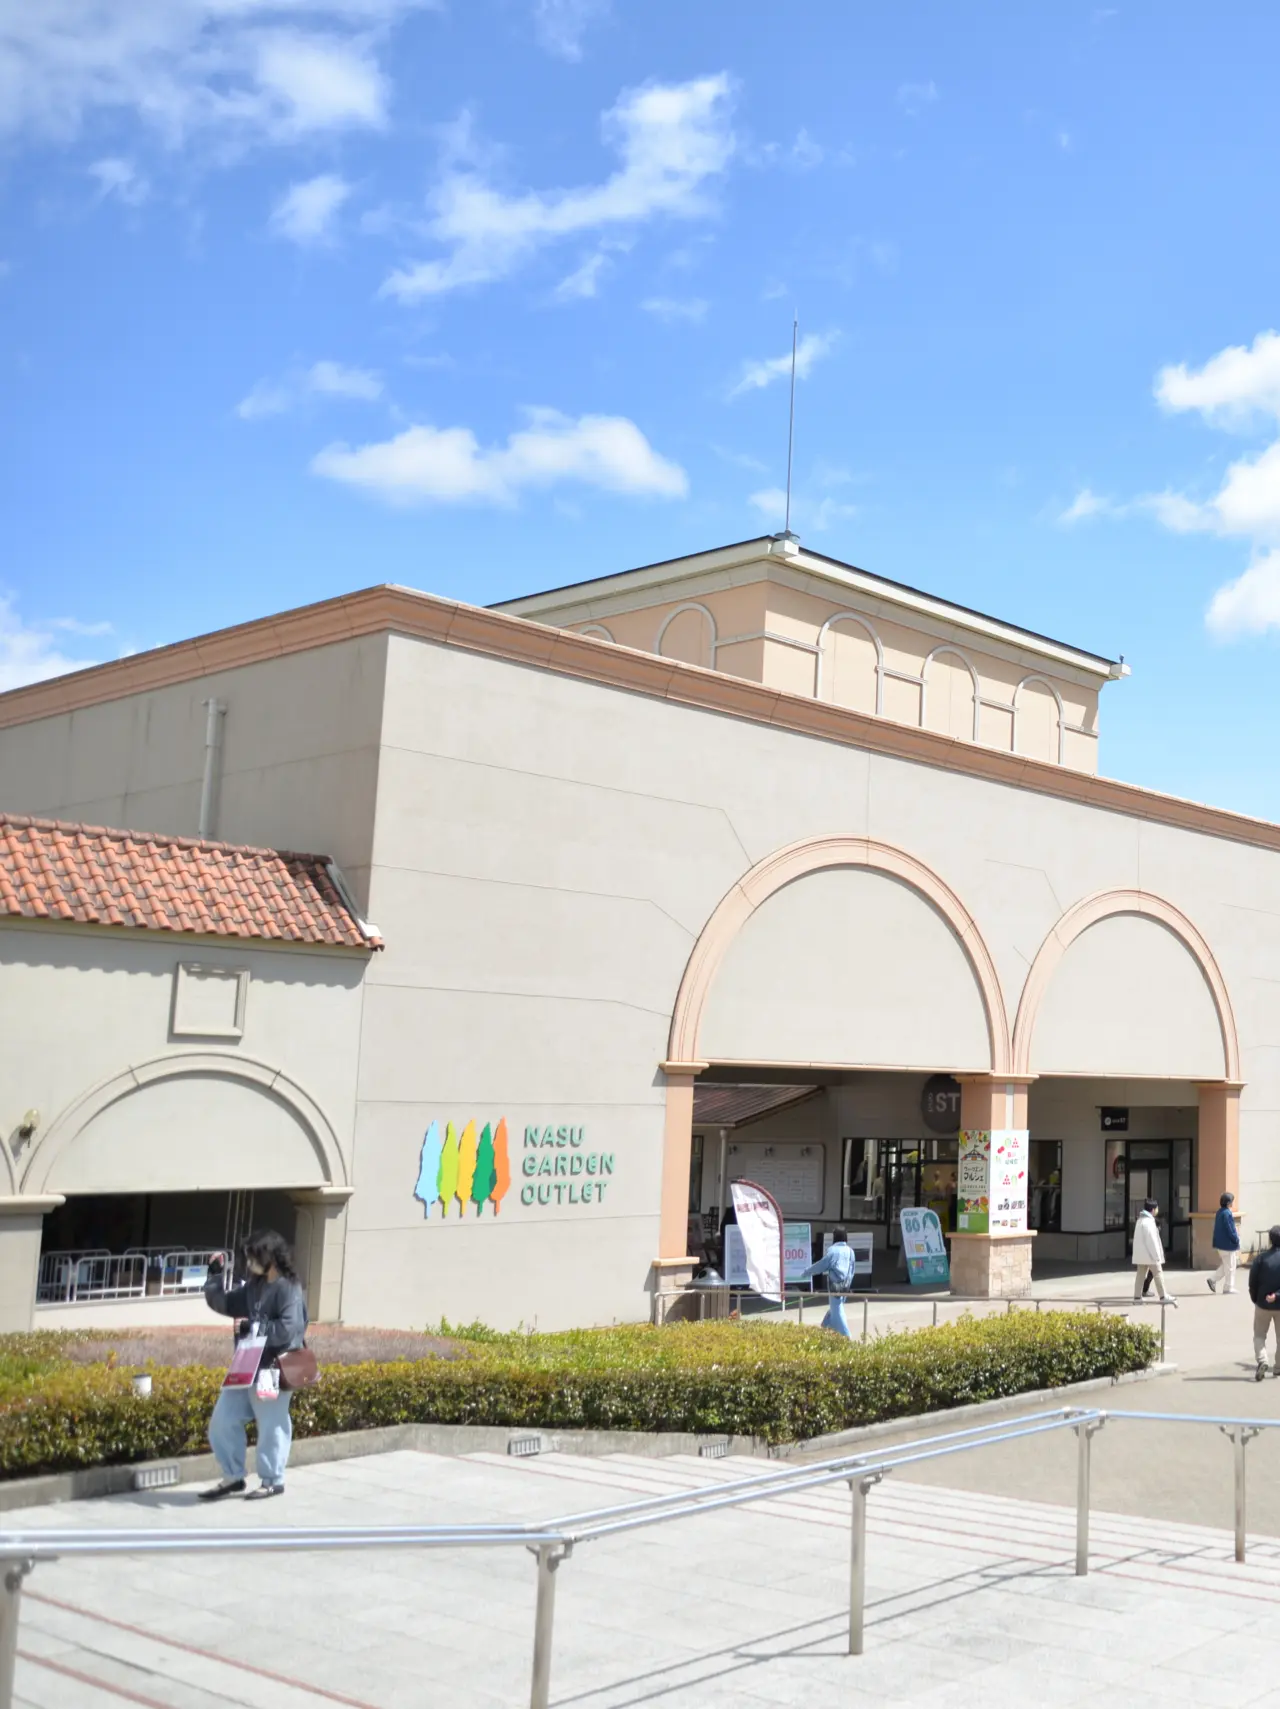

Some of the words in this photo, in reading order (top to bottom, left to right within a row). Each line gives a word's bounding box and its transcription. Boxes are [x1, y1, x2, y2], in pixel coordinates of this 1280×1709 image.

[524, 1124, 585, 1148] NASU
[522, 1151, 615, 1177] GARDEN
[521, 1180, 609, 1206] OUTLET
